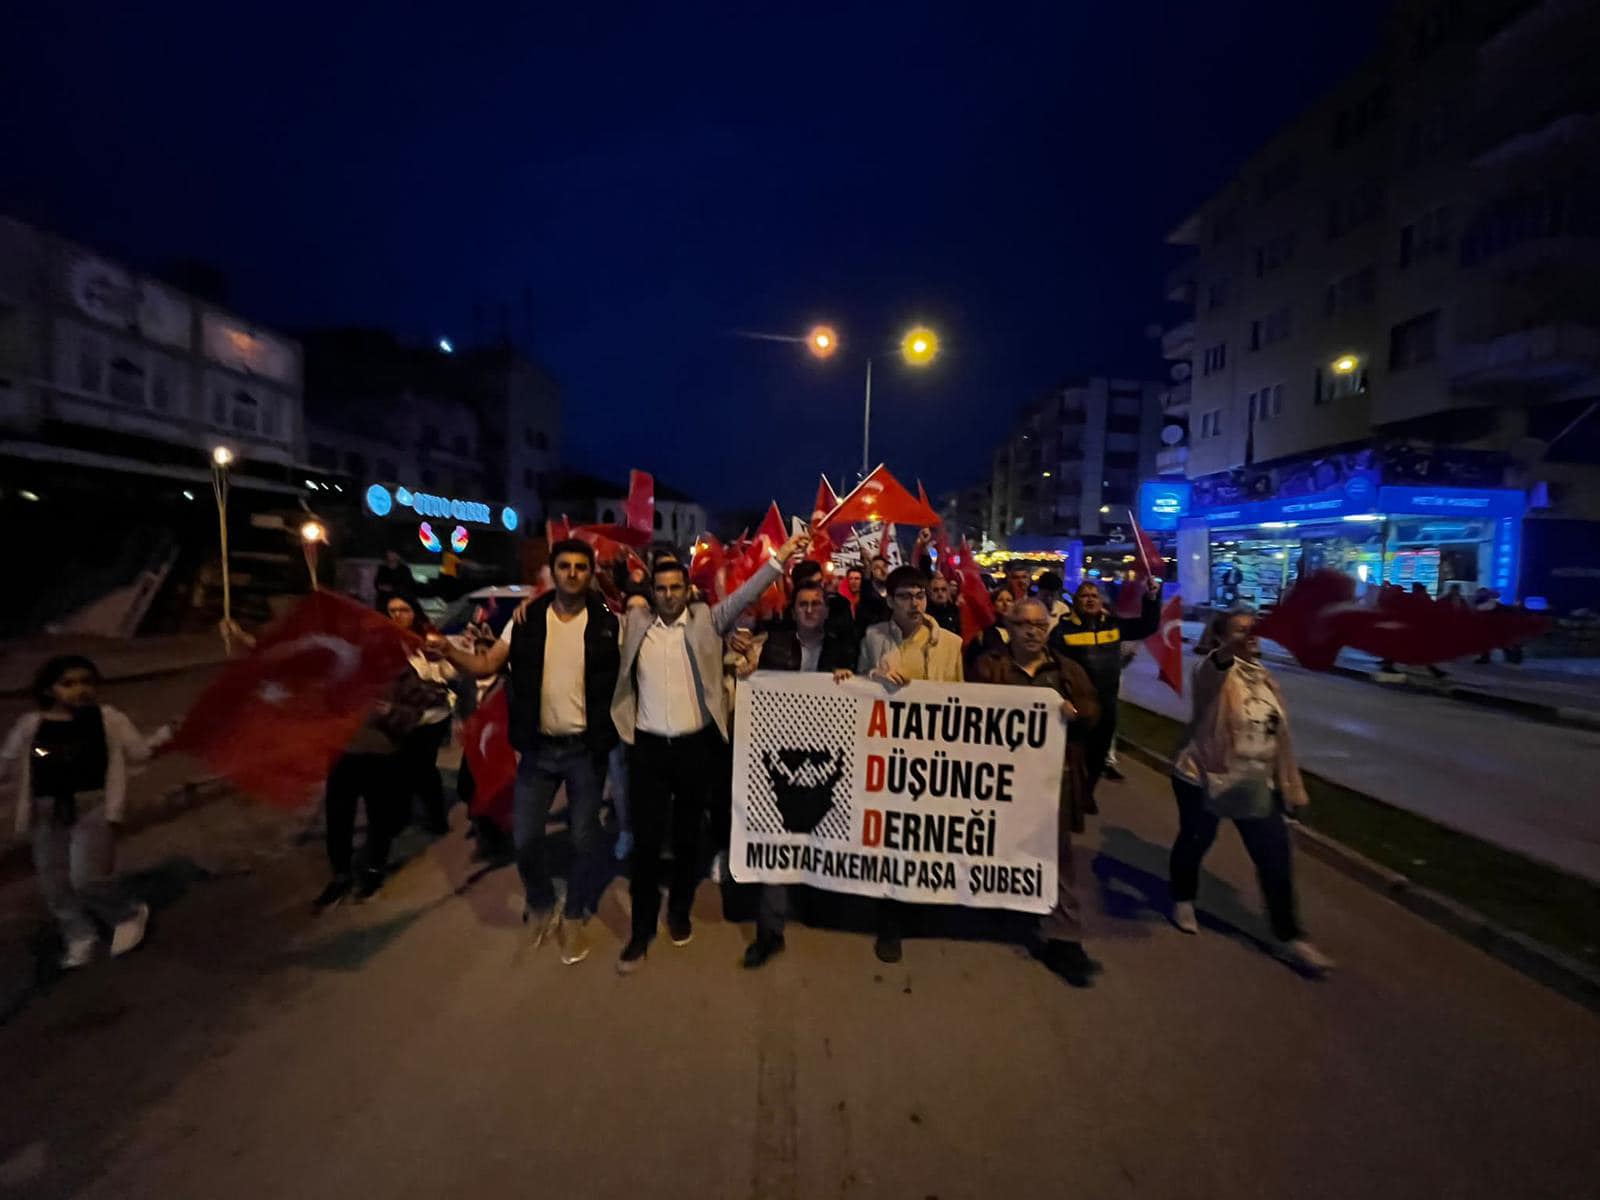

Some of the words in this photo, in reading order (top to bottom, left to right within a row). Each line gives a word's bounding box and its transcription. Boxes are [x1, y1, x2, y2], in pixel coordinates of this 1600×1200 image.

[867, 697, 1048, 752] ATATÜRKÇÜ
[865, 748, 1014, 802] DÜŞÜNCE
[862, 807, 996, 857] DERNEĞİ
[746, 841, 956, 893] MUSTAFAKEMALPAŞA
[968, 863, 1043, 897] ŞUBESİ
